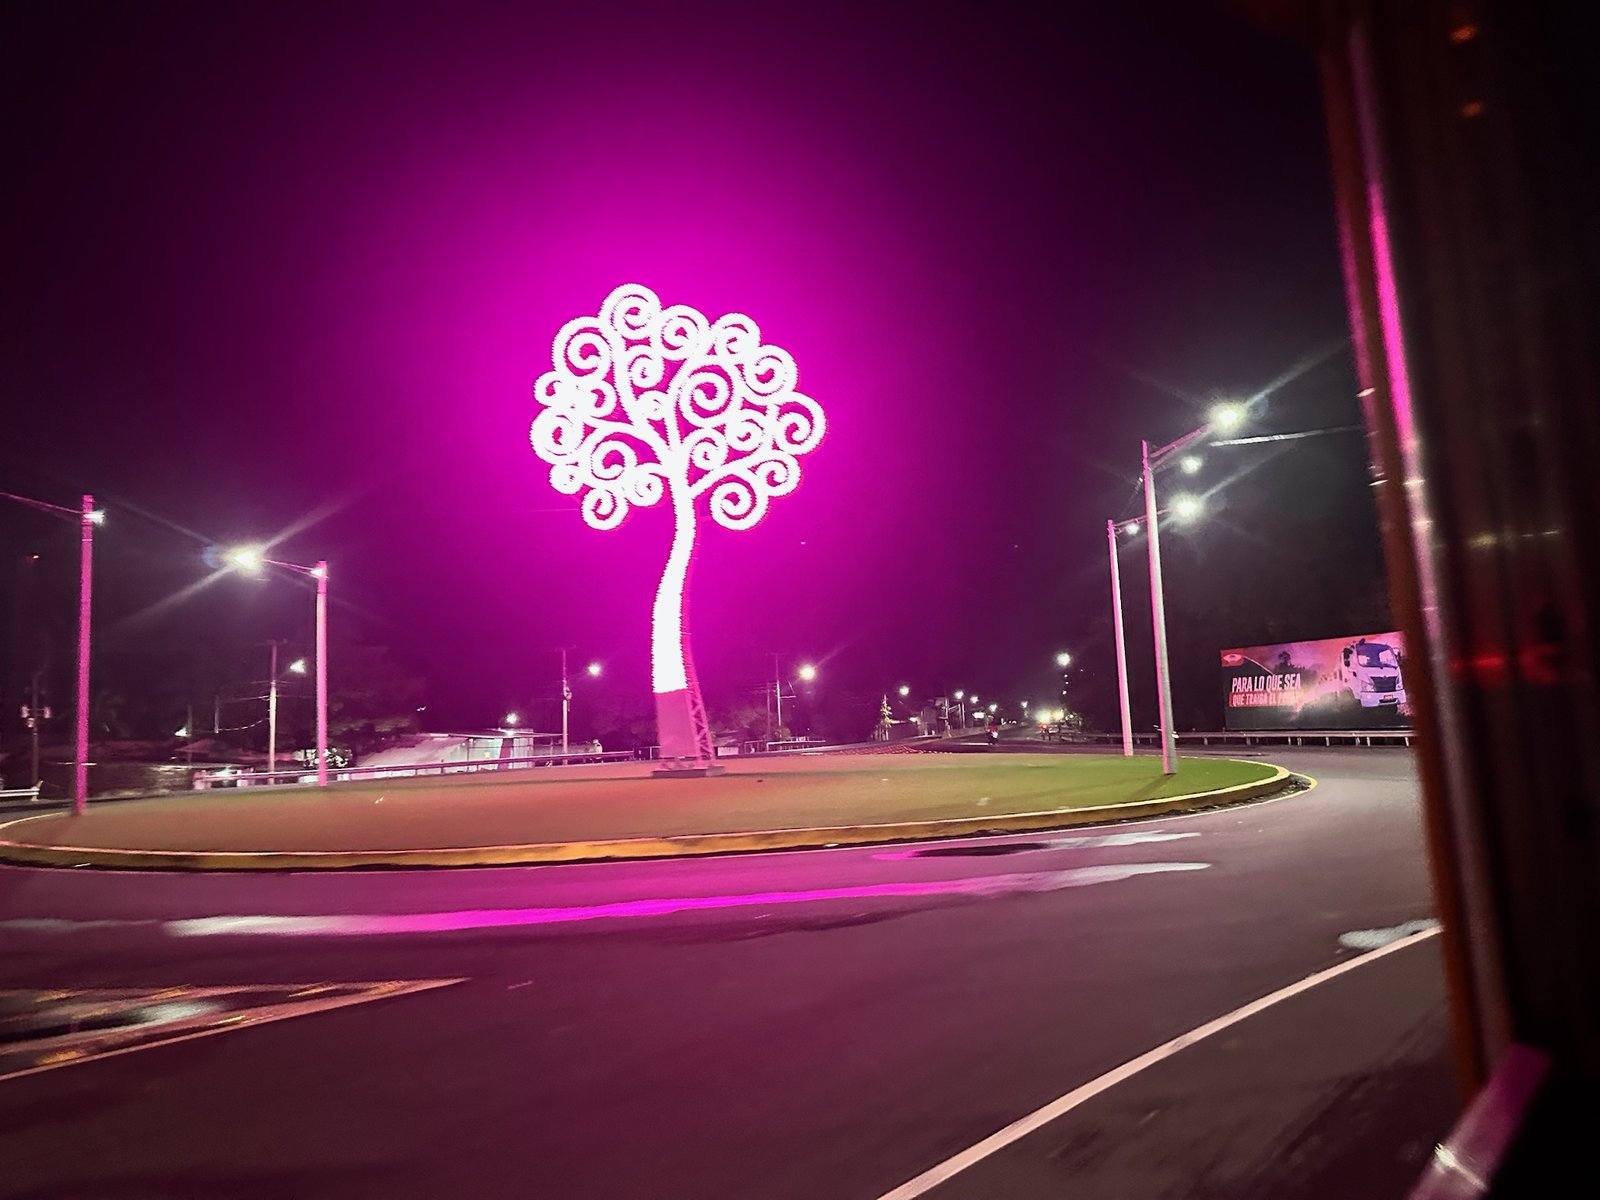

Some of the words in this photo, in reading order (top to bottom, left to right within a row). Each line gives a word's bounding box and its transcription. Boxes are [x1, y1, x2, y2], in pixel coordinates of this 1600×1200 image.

[1232, 677, 1253, 692] PARA
[1254, 676, 1265, 691] LO
[1266, 675, 1283, 693] QUE
[1284, 673, 1301, 690] SEA
[1232, 694, 1245, 706] QUE
